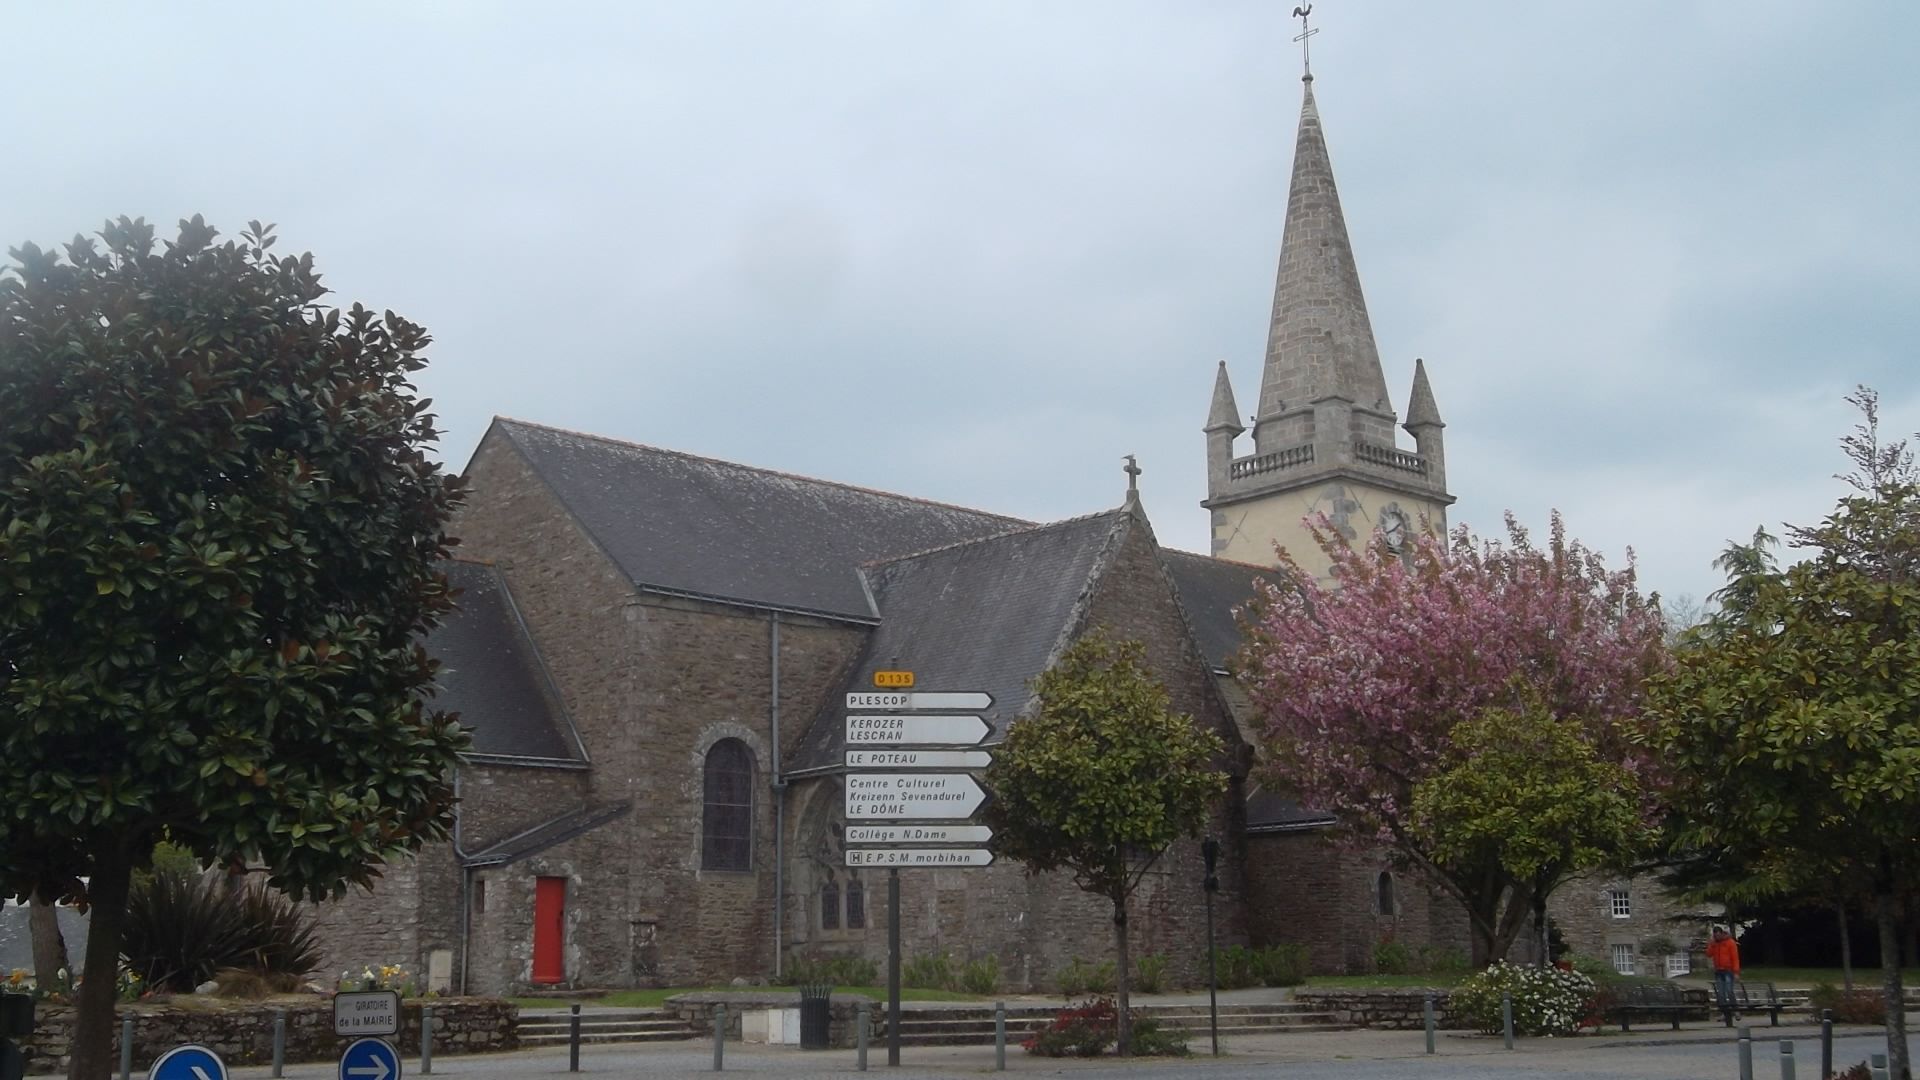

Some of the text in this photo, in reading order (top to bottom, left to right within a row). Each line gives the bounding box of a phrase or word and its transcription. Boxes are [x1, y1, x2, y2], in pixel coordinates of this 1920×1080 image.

[850, 696, 908, 705] PLESCOP
[850, 719, 904, 729] KEROZER
[850, 731, 903, 740] LESCRAN
[850, 754, 917, 764] LE POTEAU
[850, 779, 946, 788] Centre Culturel
[850, 791, 966, 801] Kreizenn Sevenadurel
[850, 803, 905, 814] LE DÔME
[850, 829, 947, 841] Collège N.Dame
[916, 853, 971, 863] morbihan
[355, 1000, 388, 1011] GIRATOIRE
[339, 1015, 393, 1027] de la MAIRIE
